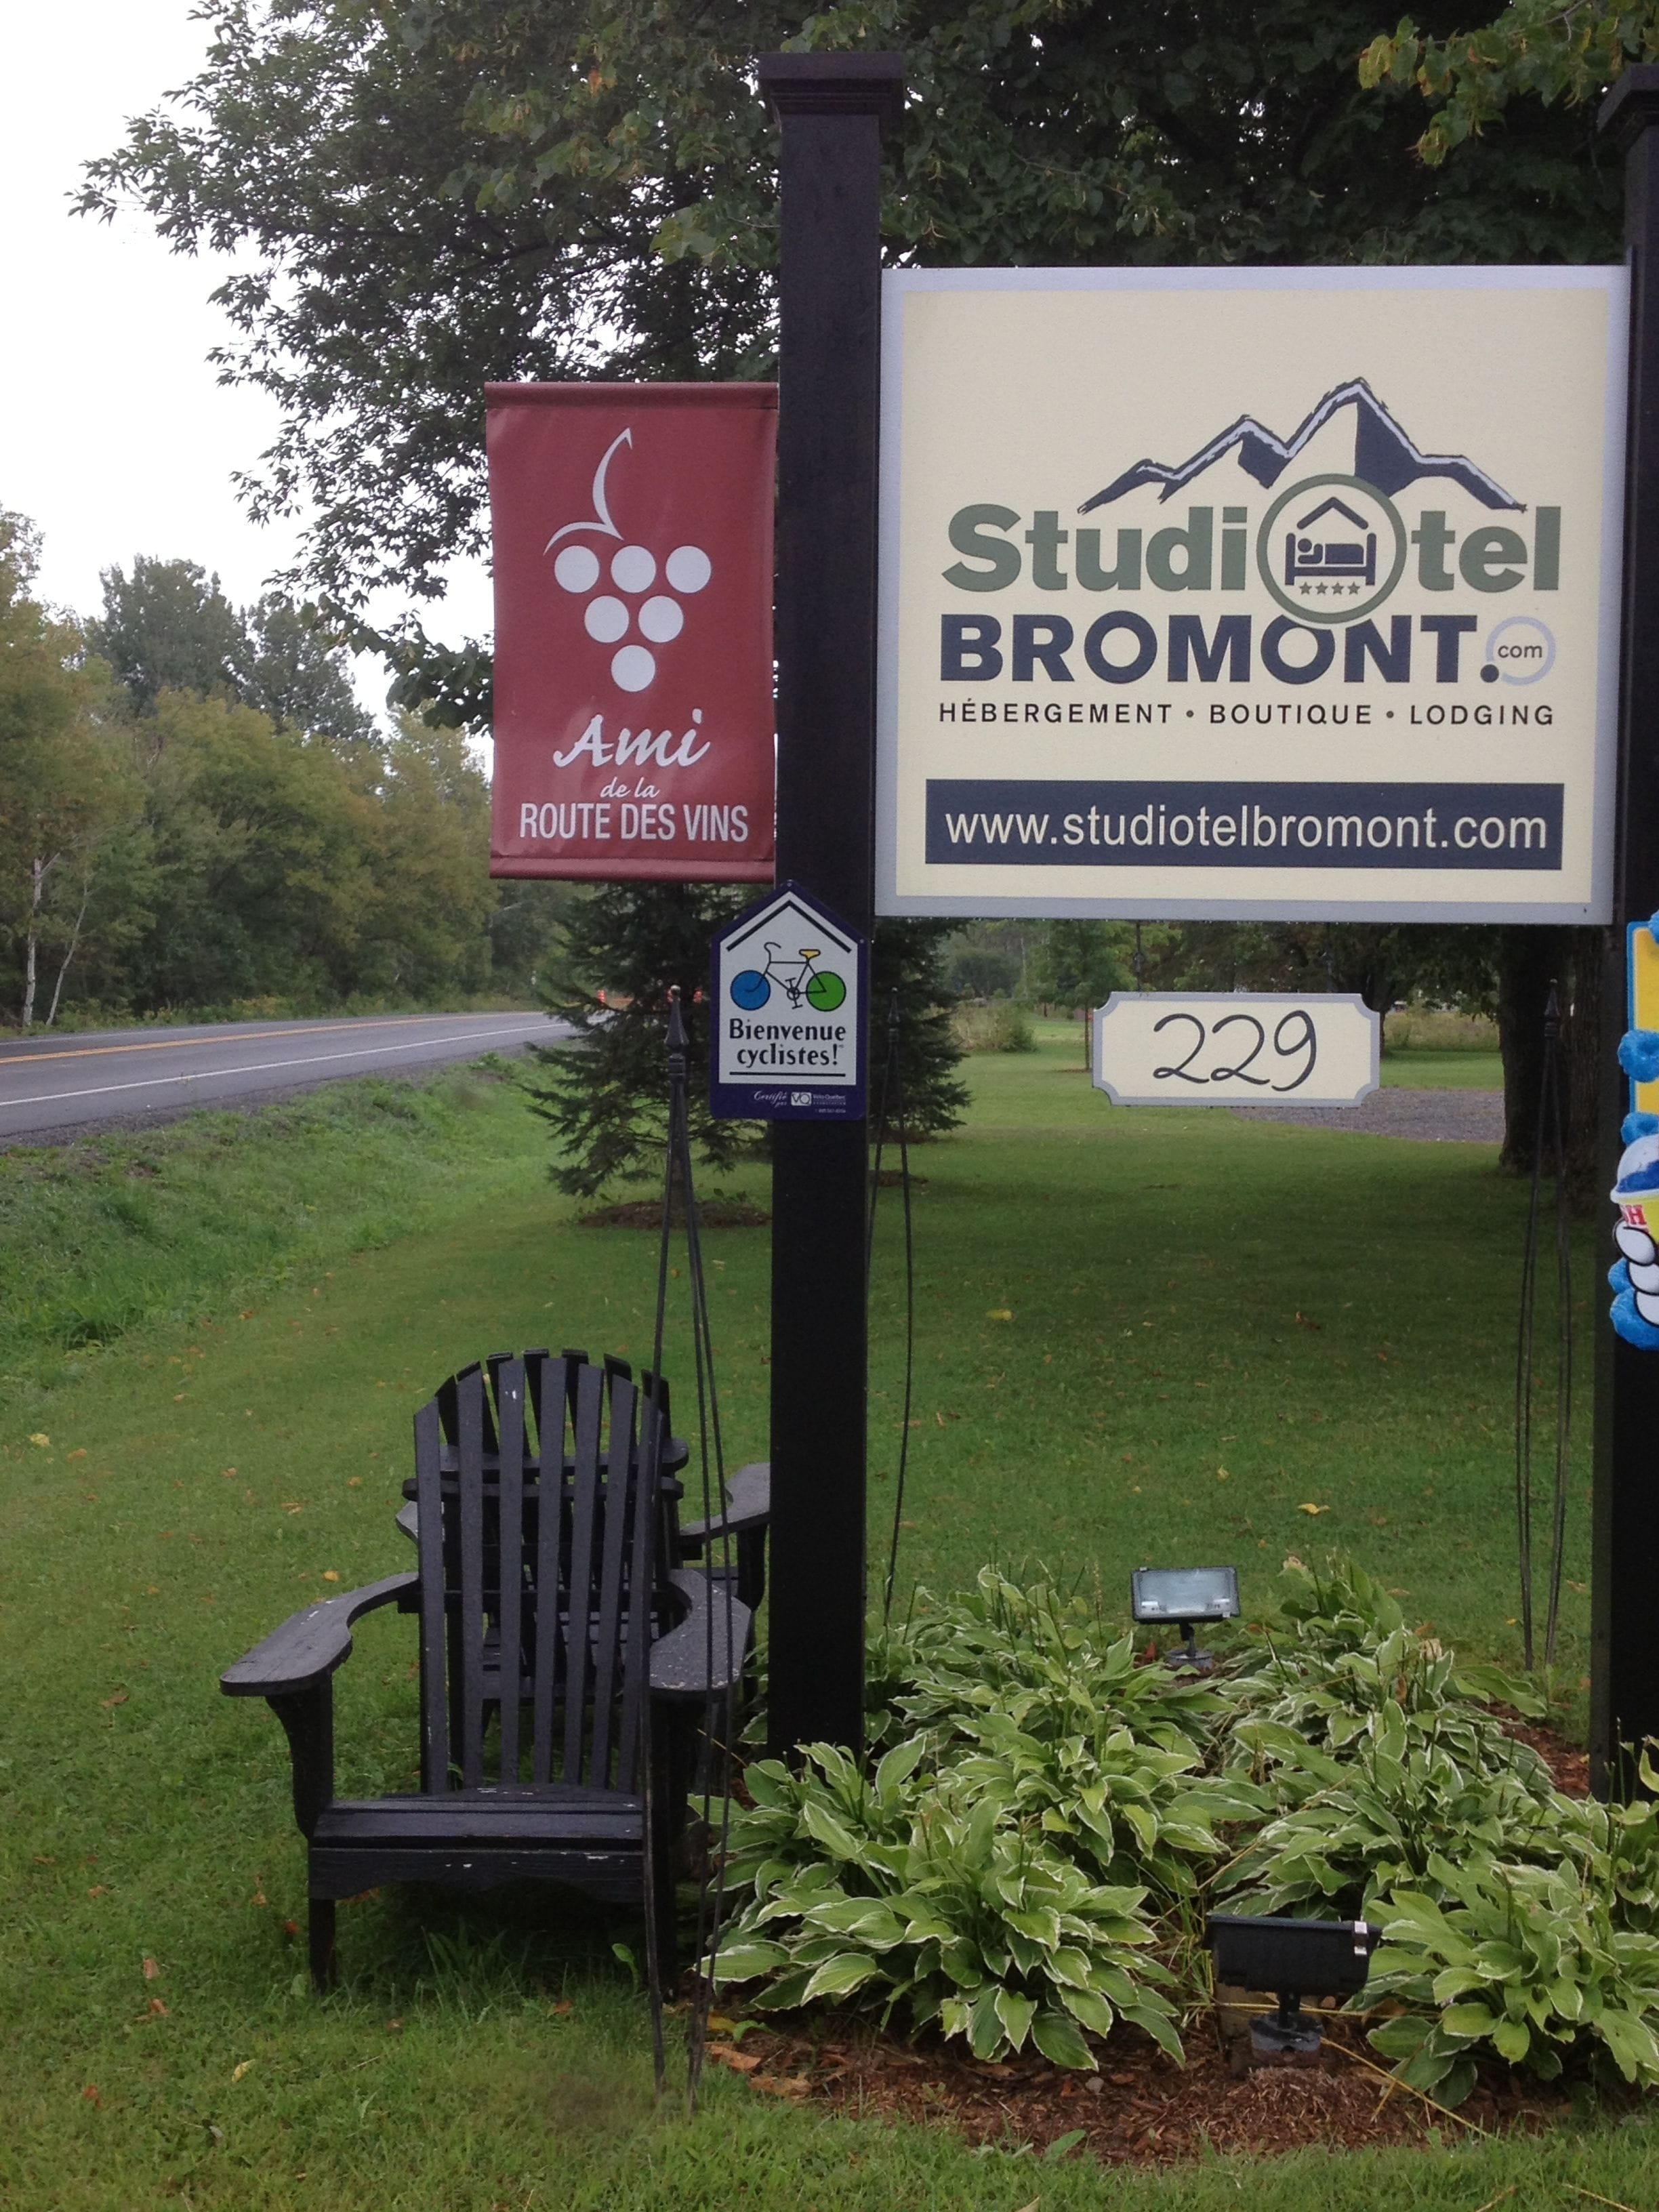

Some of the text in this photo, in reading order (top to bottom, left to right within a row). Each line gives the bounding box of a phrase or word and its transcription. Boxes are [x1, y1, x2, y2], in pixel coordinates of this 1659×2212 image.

[939, 699, 1553, 725] HÉBERGEMENT BOUTIQUE LODGING
[553, 708, 710, 767] Ami
[600, 777, 659, 798] de la
[519, 802, 748, 842] ROUTE DES VINS
[945, 804, 1547, 849] www.studiotelbromont.com
[729, 1018, 846, 1041] Bienvenue
[737, 1042, 838, 1068] cyclistes!
[1152, 1010, 1317, 1092] 229
